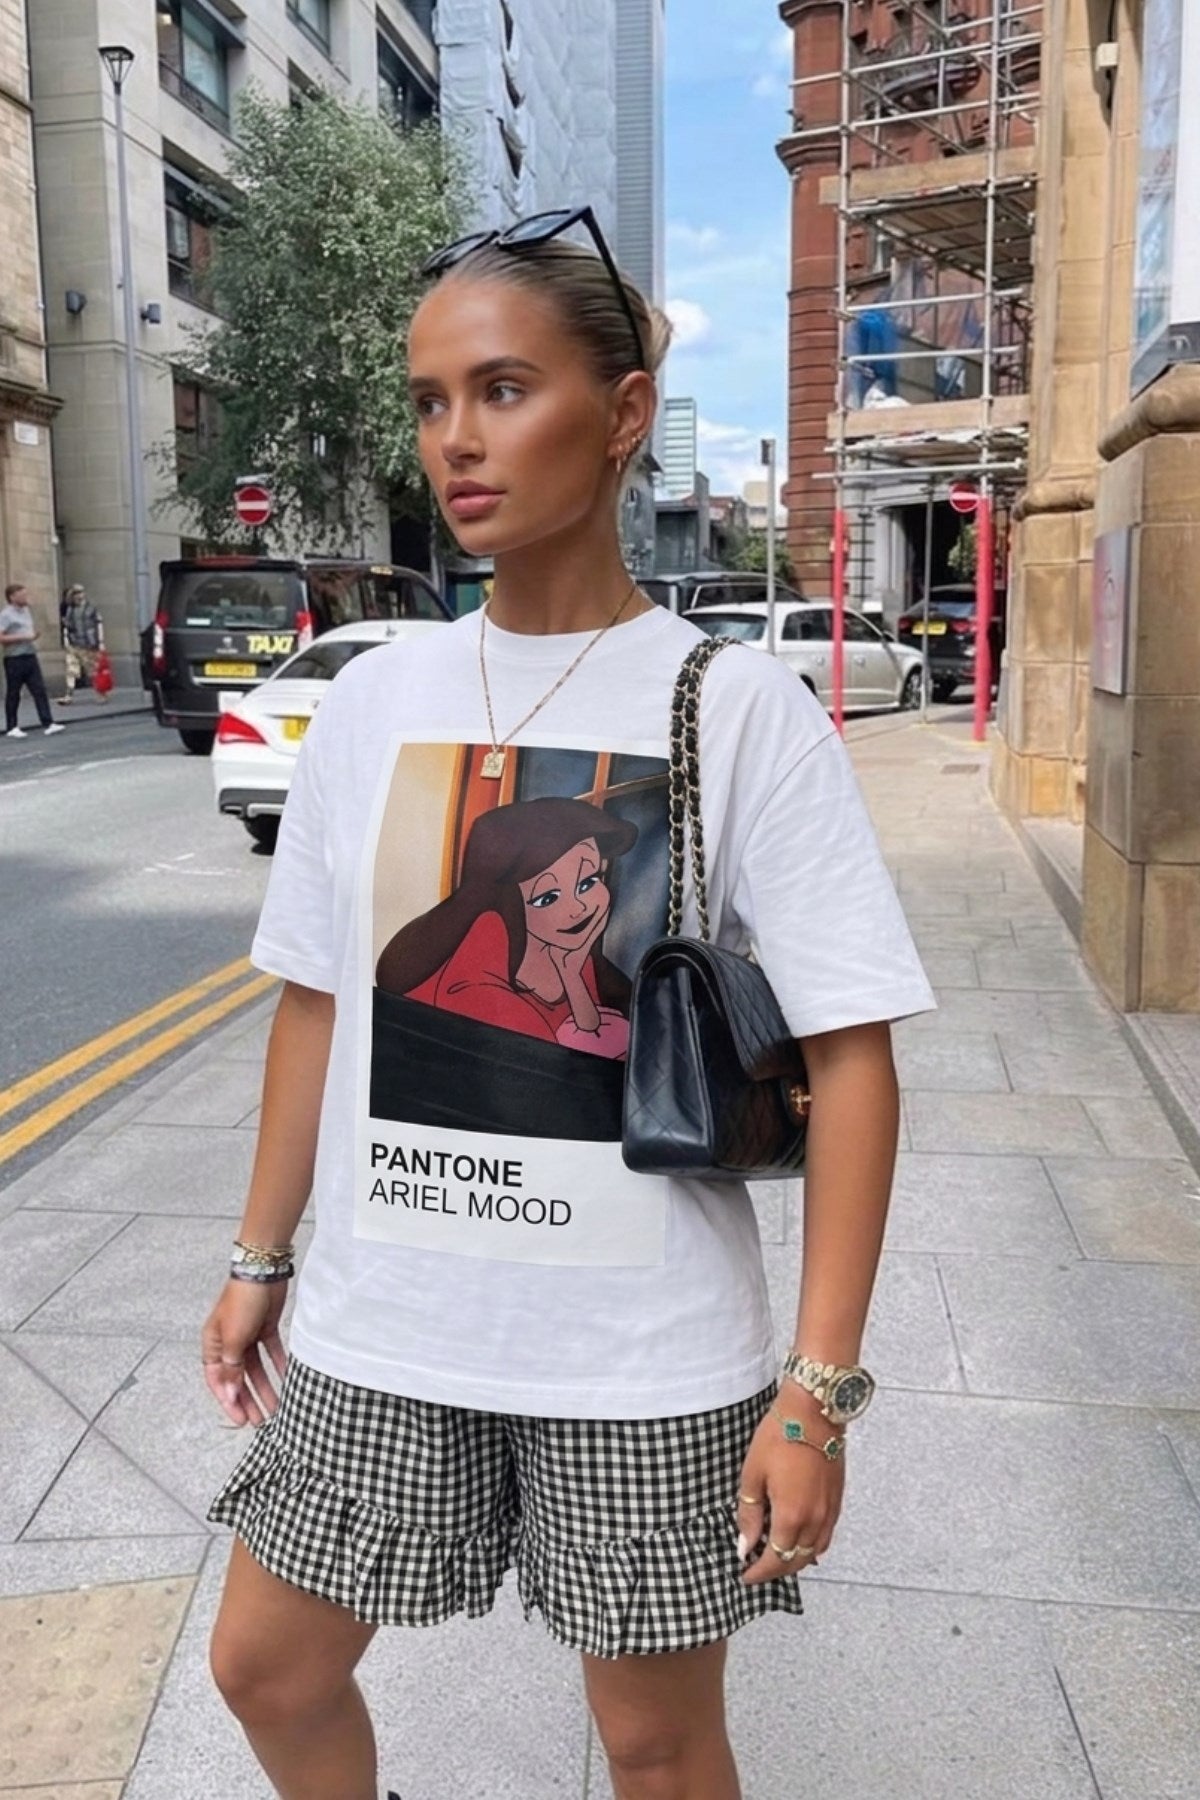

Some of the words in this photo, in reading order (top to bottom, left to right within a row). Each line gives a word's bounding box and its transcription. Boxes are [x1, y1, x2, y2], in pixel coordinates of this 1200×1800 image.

[247, 635, 294, 654] TAXI
[370, 1142, 523, 1188] PANTONE
[369, 1178, 457, 1215] ARIEL
[468, 1191, 572, 1226] MOOD
